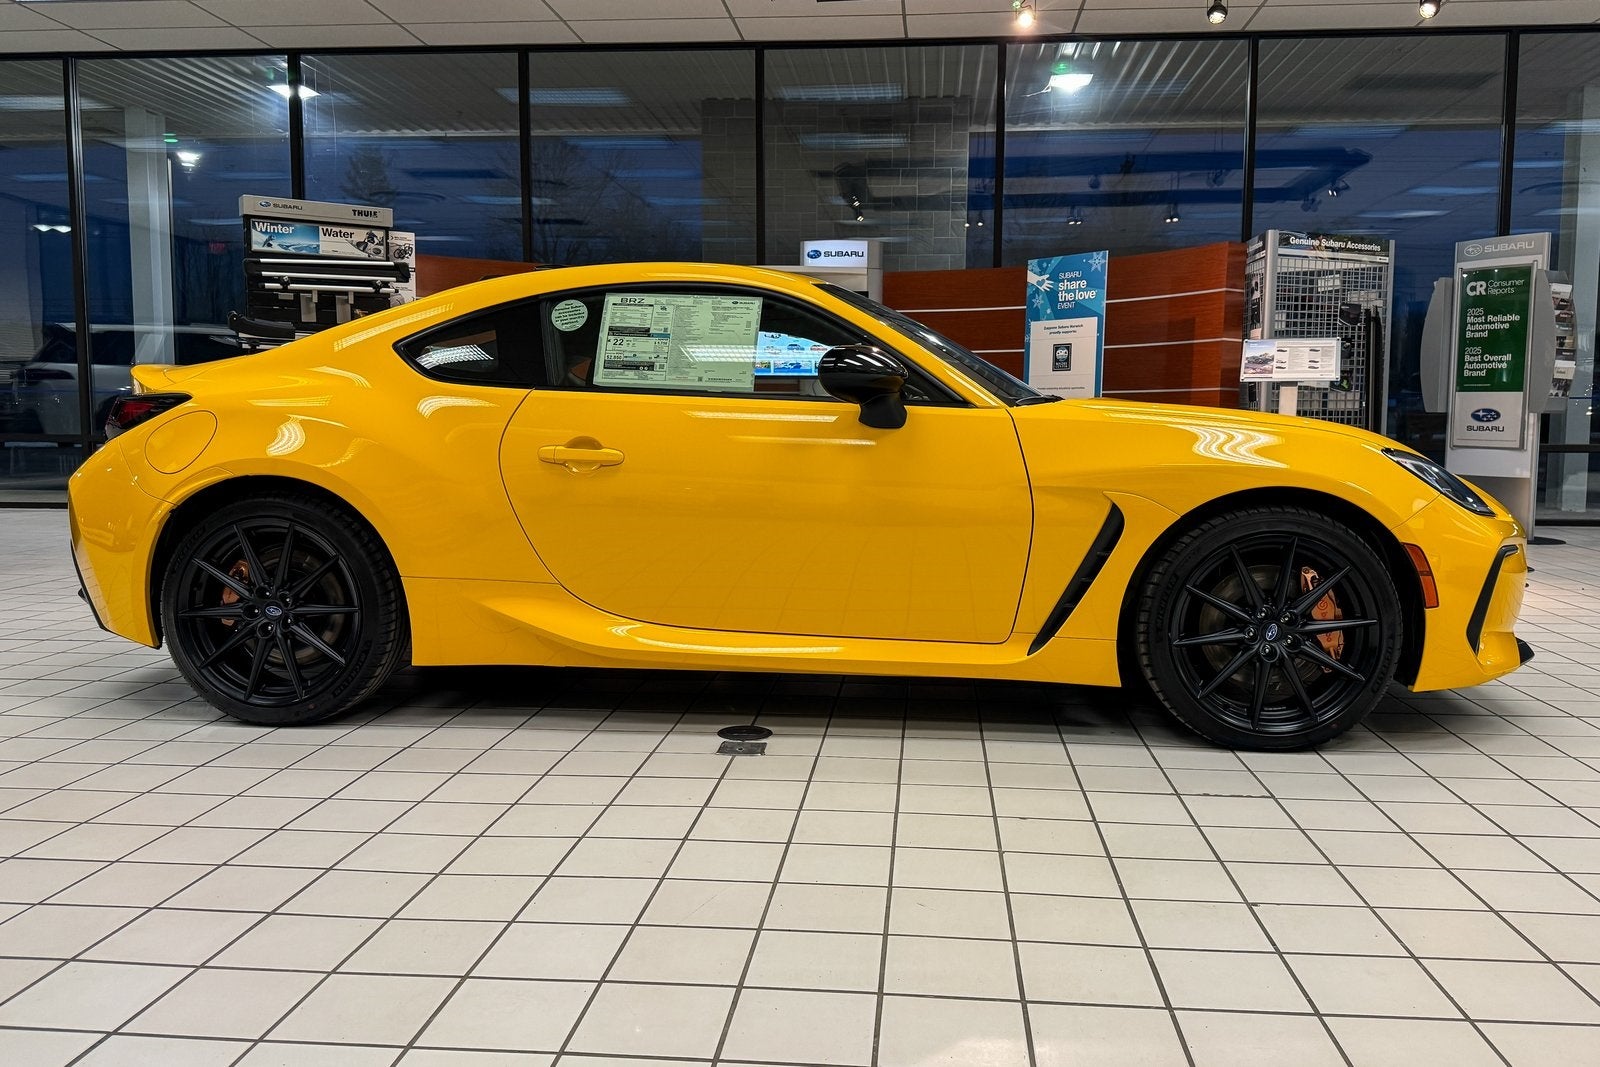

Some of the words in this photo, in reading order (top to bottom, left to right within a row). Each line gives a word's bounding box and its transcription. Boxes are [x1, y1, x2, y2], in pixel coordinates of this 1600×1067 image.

[352, 209, 378, 218] THULE
[254, 222, 294, 234] Winter
[322, 228, 354, 239] Water
[1290, 236, 1320, 247] Genuine
[1321, 239, 1345, 249] Subaru
[1346, 241, 1381, 251] Accessories
[1484, 241, 1534, 253] SUBARU
[1059, 271, 1082, 279] SUBARU
[1058, 280, 1087, 290] share
[1466, 281, 1487, 296] CR
[1488, 279, 1524, 288] Consumer
[1488, 287, 1515, 295] Reports
[1058, 291, 1074, 301] the
[1076, 290, 1096, 300] love
[1467, 308, 1484, 316] 2025
[1487, 314, 1520, 322] Reliable
[1466, 323, 1509, 331] Automotive
[1466, 330, 1488, 338] Brand
[1465, 347, 1482, 355] 2025
[1464, 354, 1481, 362] Best
